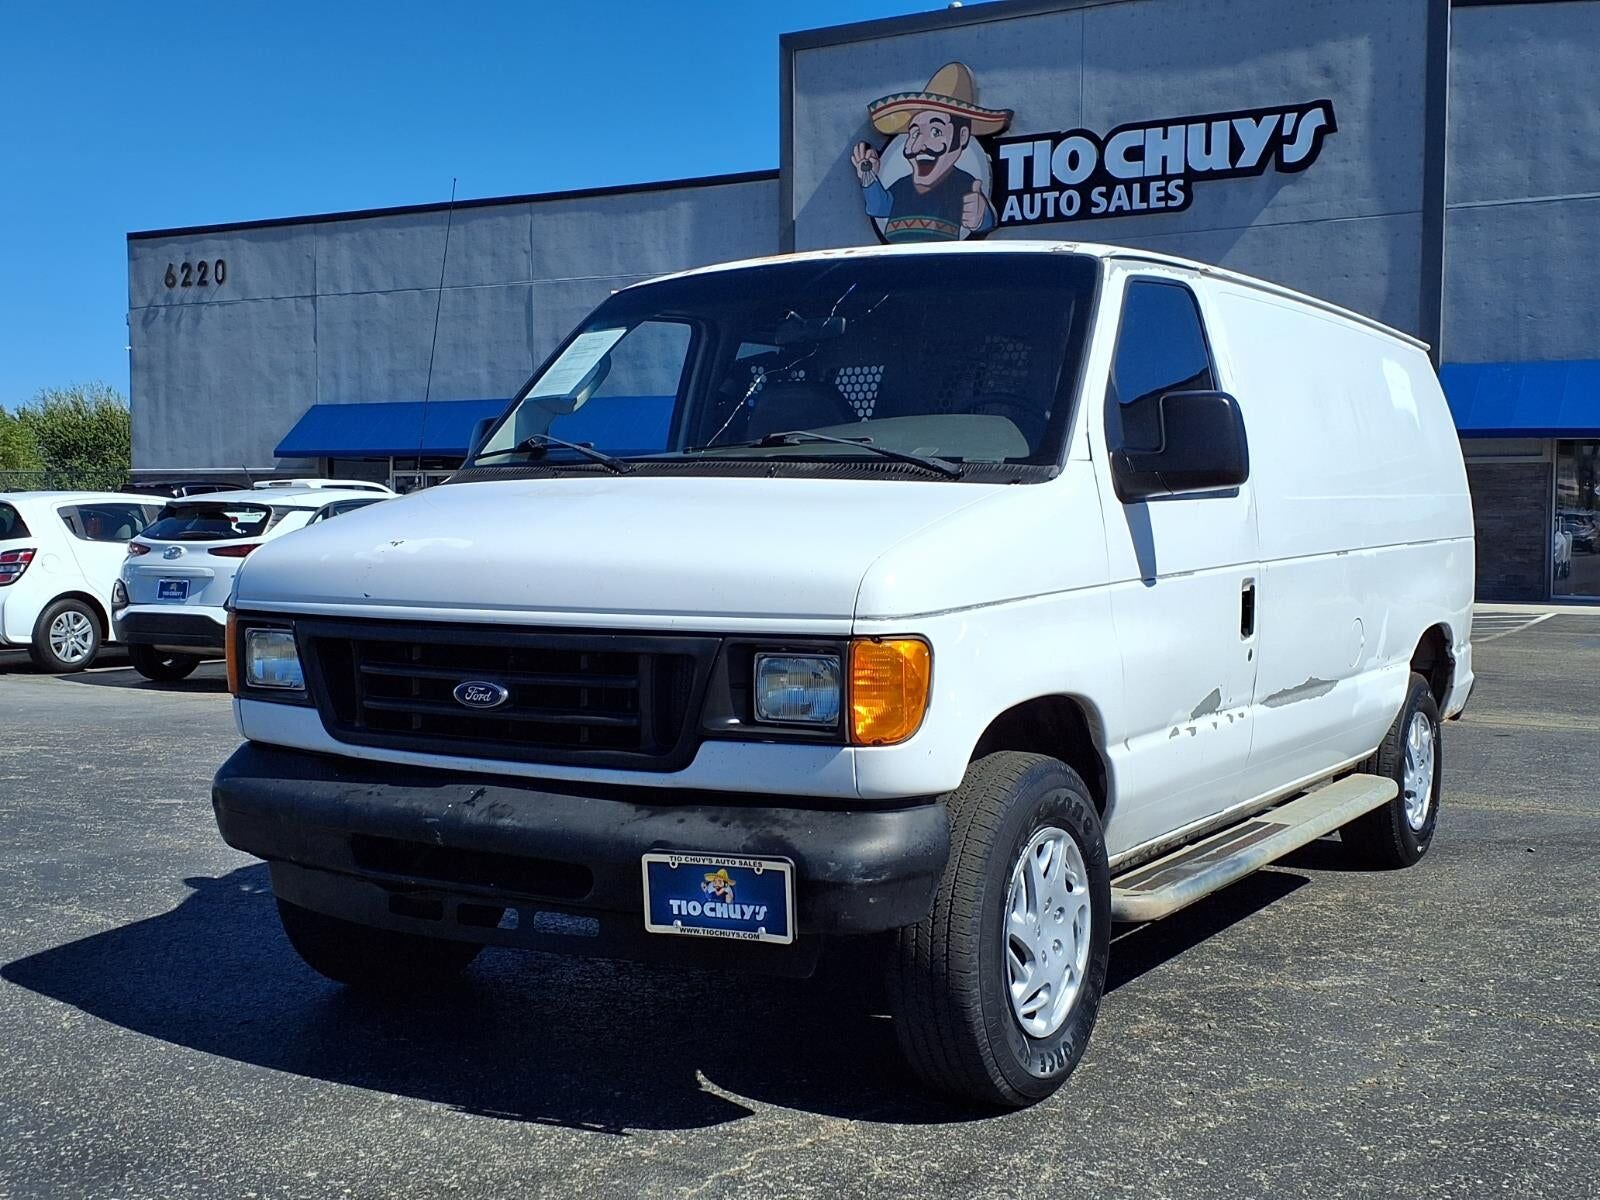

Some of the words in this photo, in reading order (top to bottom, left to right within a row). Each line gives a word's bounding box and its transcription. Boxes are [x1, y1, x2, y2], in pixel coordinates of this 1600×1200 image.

[1000, 135, 1097, 190] TIO
[1104, 107, 1327, 178] CHUY'S
[1001, 189, 1081, 222] AUTO
[1091, 179, 1185, 214] SALES
[164, 259, 225, 288] 6220
[465, 686, 492, 702] Ford
[684, 856, 713, 864] CHUY'S
[715, 858, 736, 866] AUTO
[738, 859, 763, 868] SALES
[669, 899, 702, 916] TIO
[703, 902, 767, 921] CHUY'S
[679, 926, 760, 940] WWW.TIOCHUYS.COM
